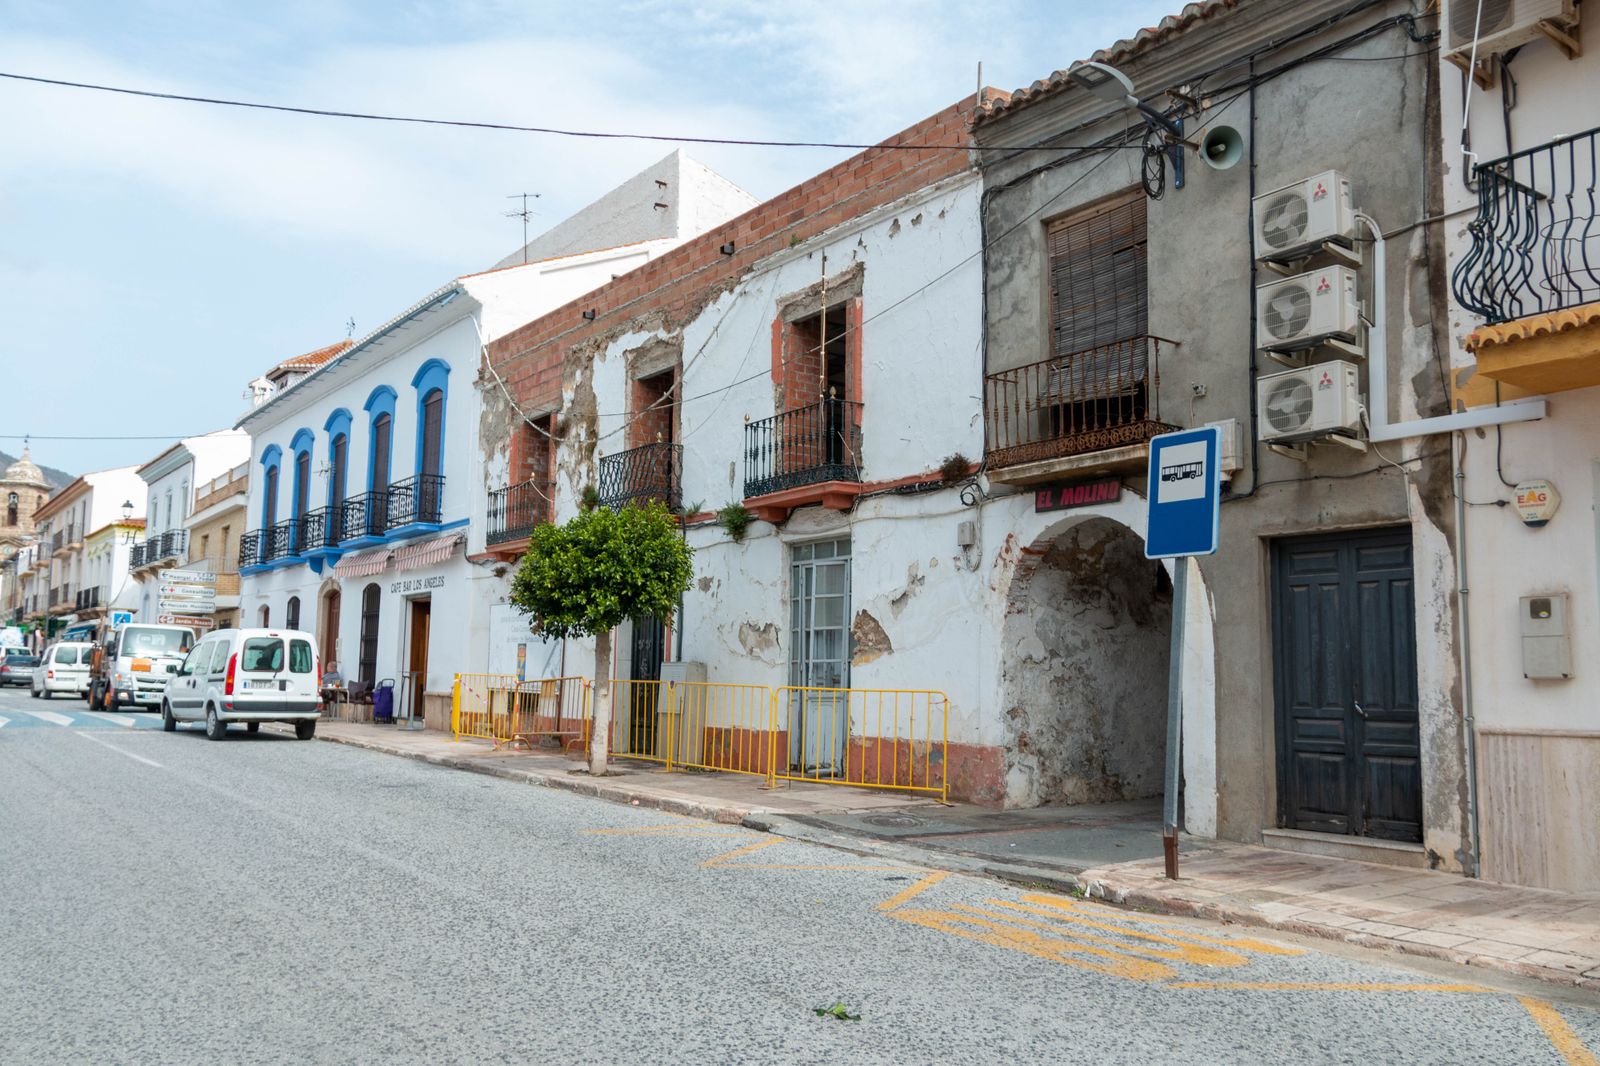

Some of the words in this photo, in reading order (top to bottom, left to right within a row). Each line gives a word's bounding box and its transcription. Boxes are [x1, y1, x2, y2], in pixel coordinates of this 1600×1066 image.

[1037, 491, 1052, 508] EL
[1061, 481, 1119, 505] MOLINO
[403, 580, 412, 591] BAR
[413, 579, 422, 590] LOS
[424, 576, 445, 589] ANGELES
[885, 894, 1308, 981] BUS
